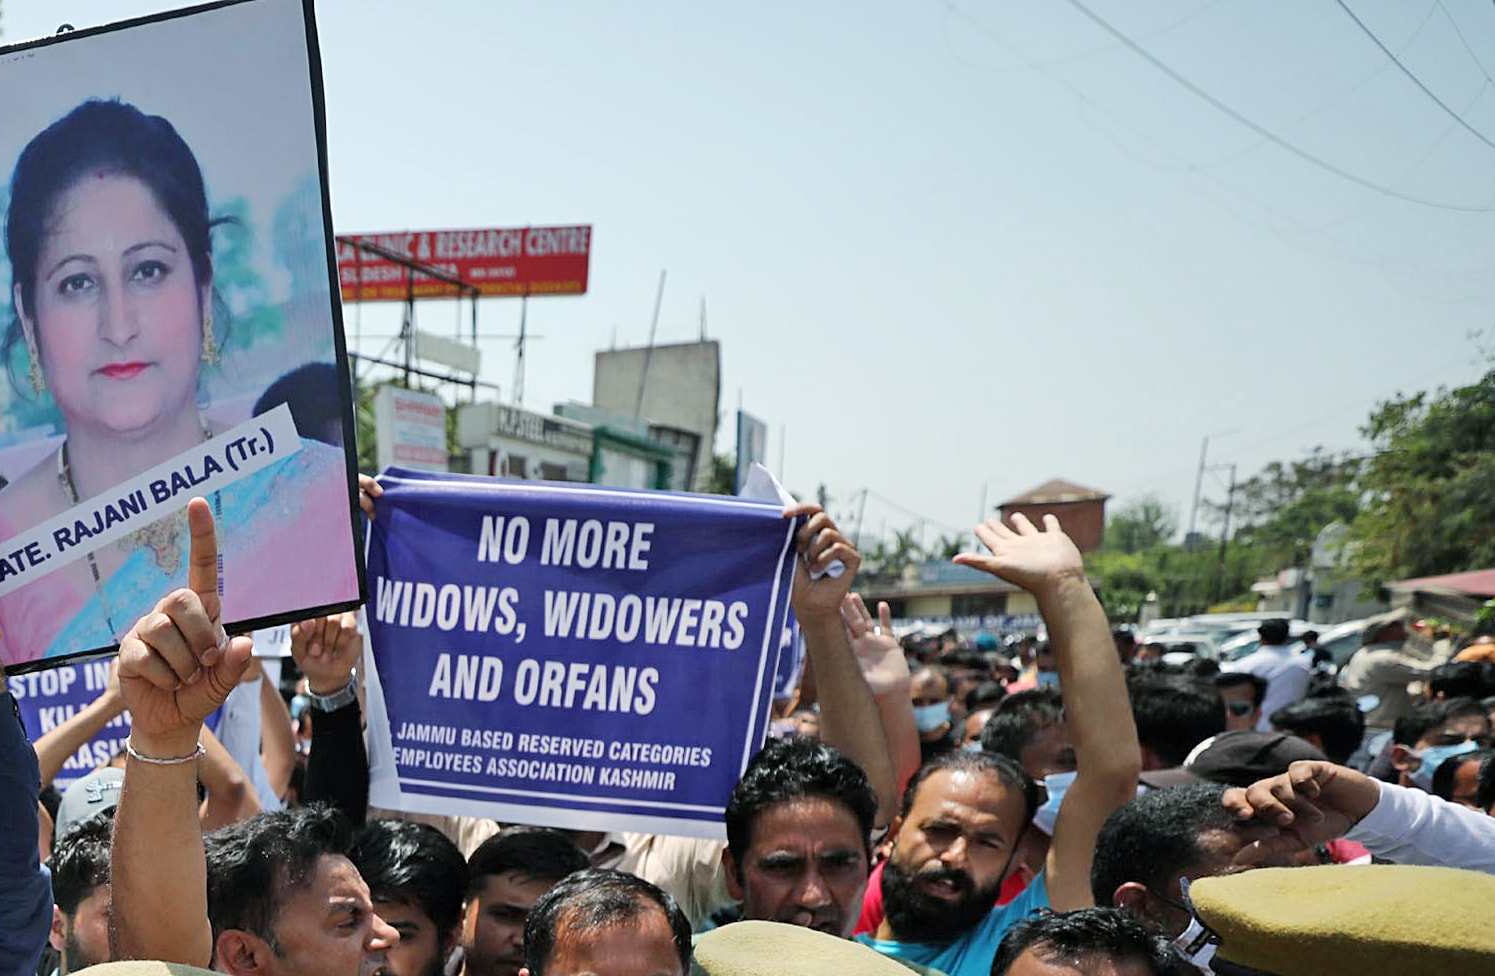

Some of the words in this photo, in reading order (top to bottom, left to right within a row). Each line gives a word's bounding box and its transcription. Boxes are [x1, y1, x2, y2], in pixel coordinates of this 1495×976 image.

[435, 229, 522, 258] RESEARCH
[525, 226, 589, 256] CENTRE
[53, 489, 148, 552] RAJANI
[149, 454, 223, 506] BALA
[224, 427, 275, 471] (Tr.)
[477, 514, 531, 565] NO
[540, 516, 656, 571] MORE
[375, 575, 529, 645] WIDOWS,
[542, 588, 749, 650] WIDOWERS
[8, 665, 76, 700] STOP
[428, 652, 504, 702] AND
[514, 657, 659, 716] ORFANS
[393, 746, 483, 775] EMPLOYEES
[486, 755, 597, 785] ASSOCIATION
[599, 767, 677, 792] KASHMIR
[396, 721, 457, 747] JAMMU
[460, 727, 514, 751] BASED
[517, 732, 605, 760] RESERVED
[608, 740, 712, 768] CATEGORIES
